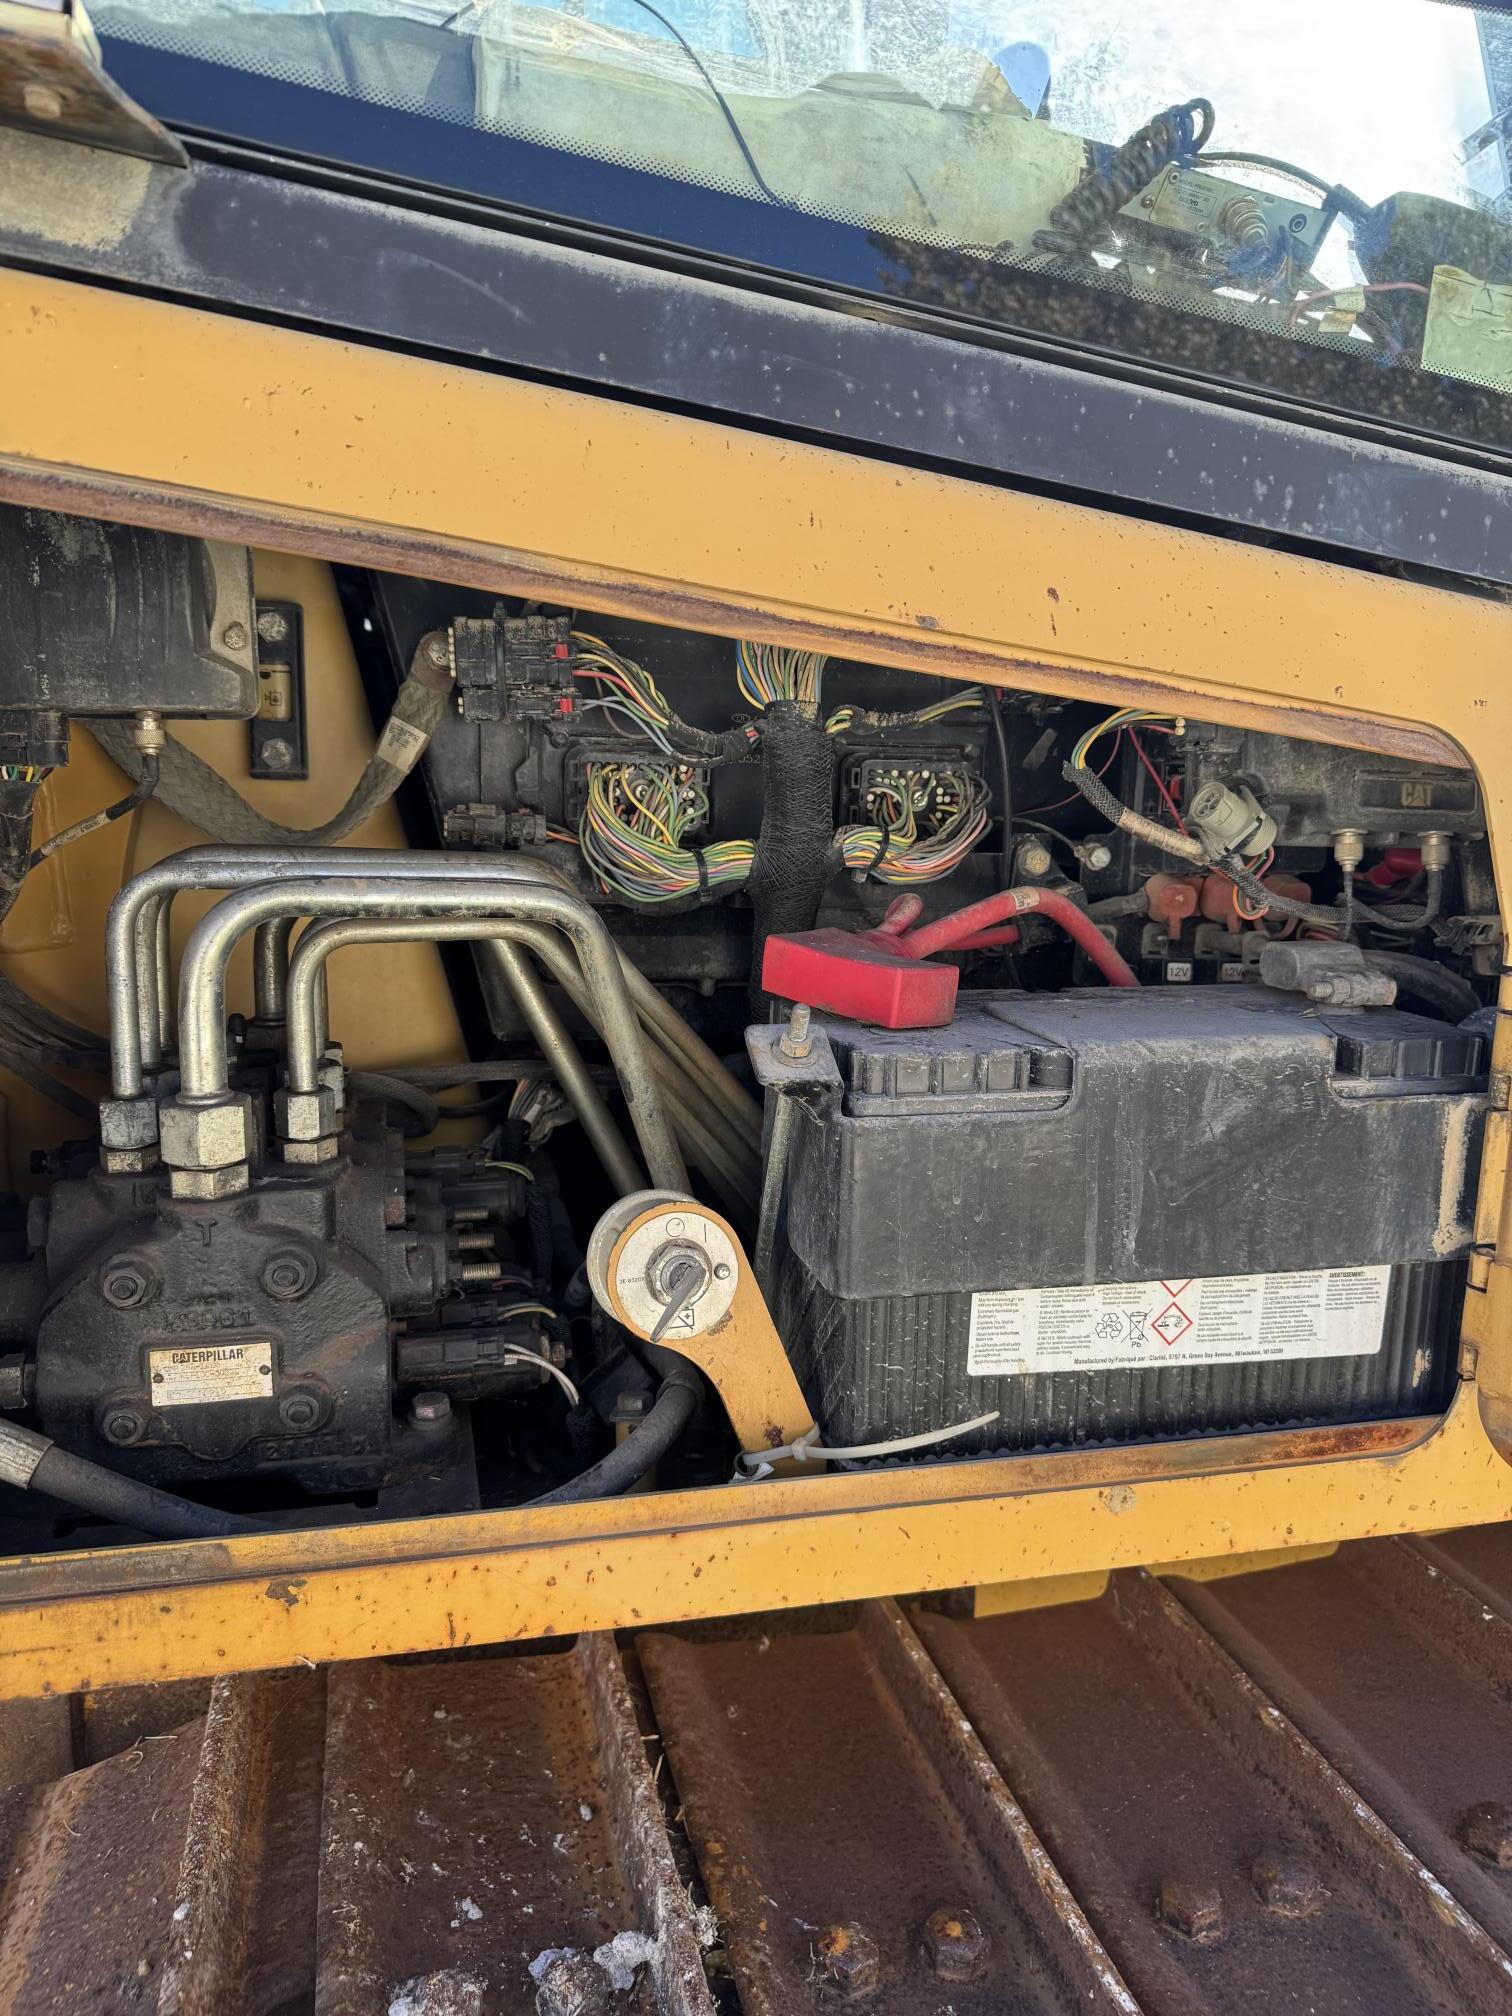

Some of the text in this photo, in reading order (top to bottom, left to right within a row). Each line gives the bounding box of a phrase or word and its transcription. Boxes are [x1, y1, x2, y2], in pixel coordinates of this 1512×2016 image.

[1401, 782, 1432, 807] CAT
[1169, 967, 1189, 977] 12V
[172, 1348, 244, 1364] CATERPILLAR
[1073, 1356, 1106, 1364] Manufactured
